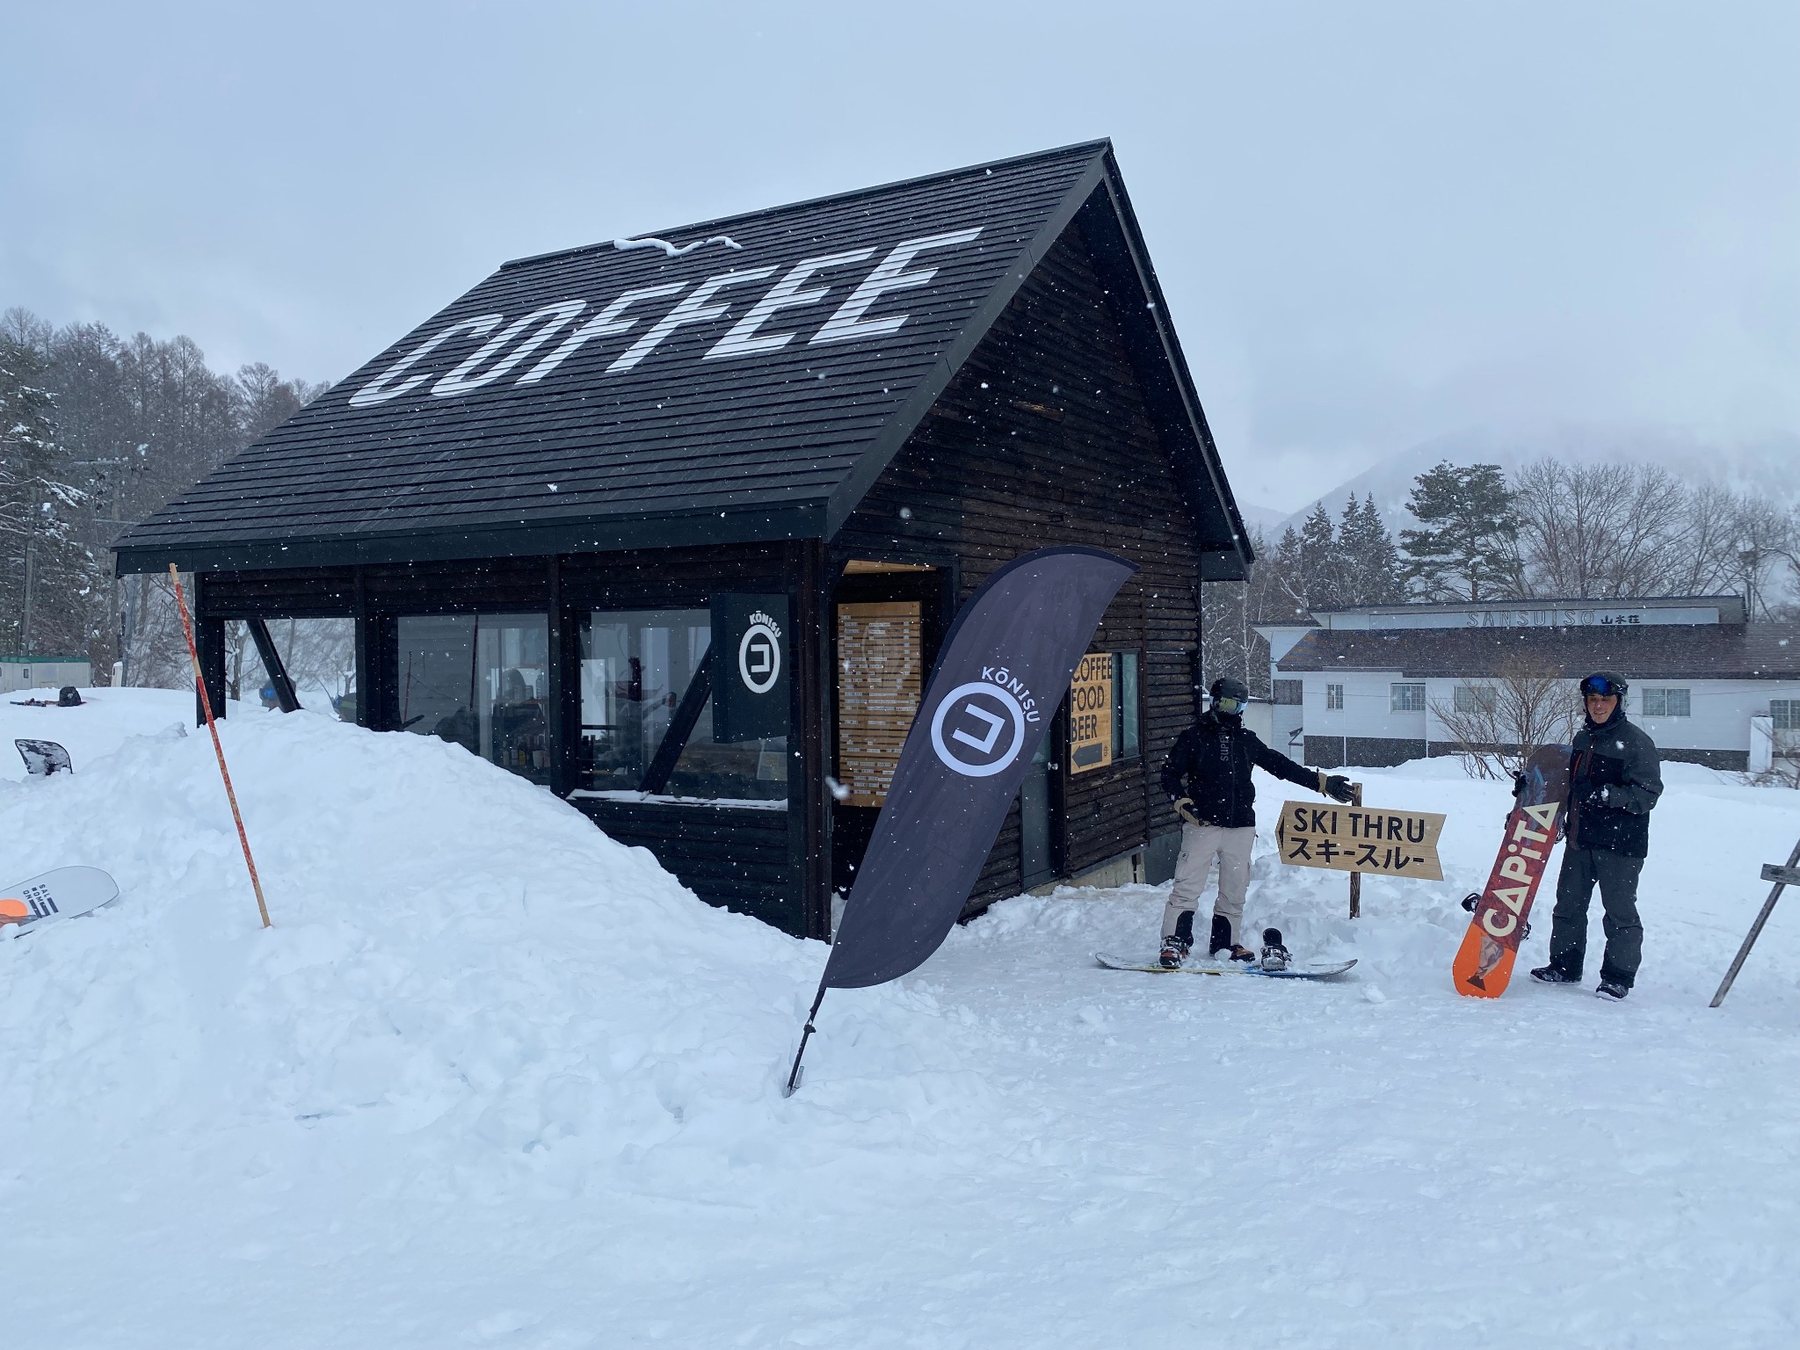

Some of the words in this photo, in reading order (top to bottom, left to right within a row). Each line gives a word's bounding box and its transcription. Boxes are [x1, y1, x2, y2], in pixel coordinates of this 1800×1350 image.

[348, 227, 984, 407] COFFEE
[1071, 686, 1105, 713] FOOD
[1071, 714, 1098, 742] BEER
[1293, 808, 1337, 835] SKI
[1348, 813, 1425, 843] THRU
[1288, 837, 1425, 870] スキースルー
